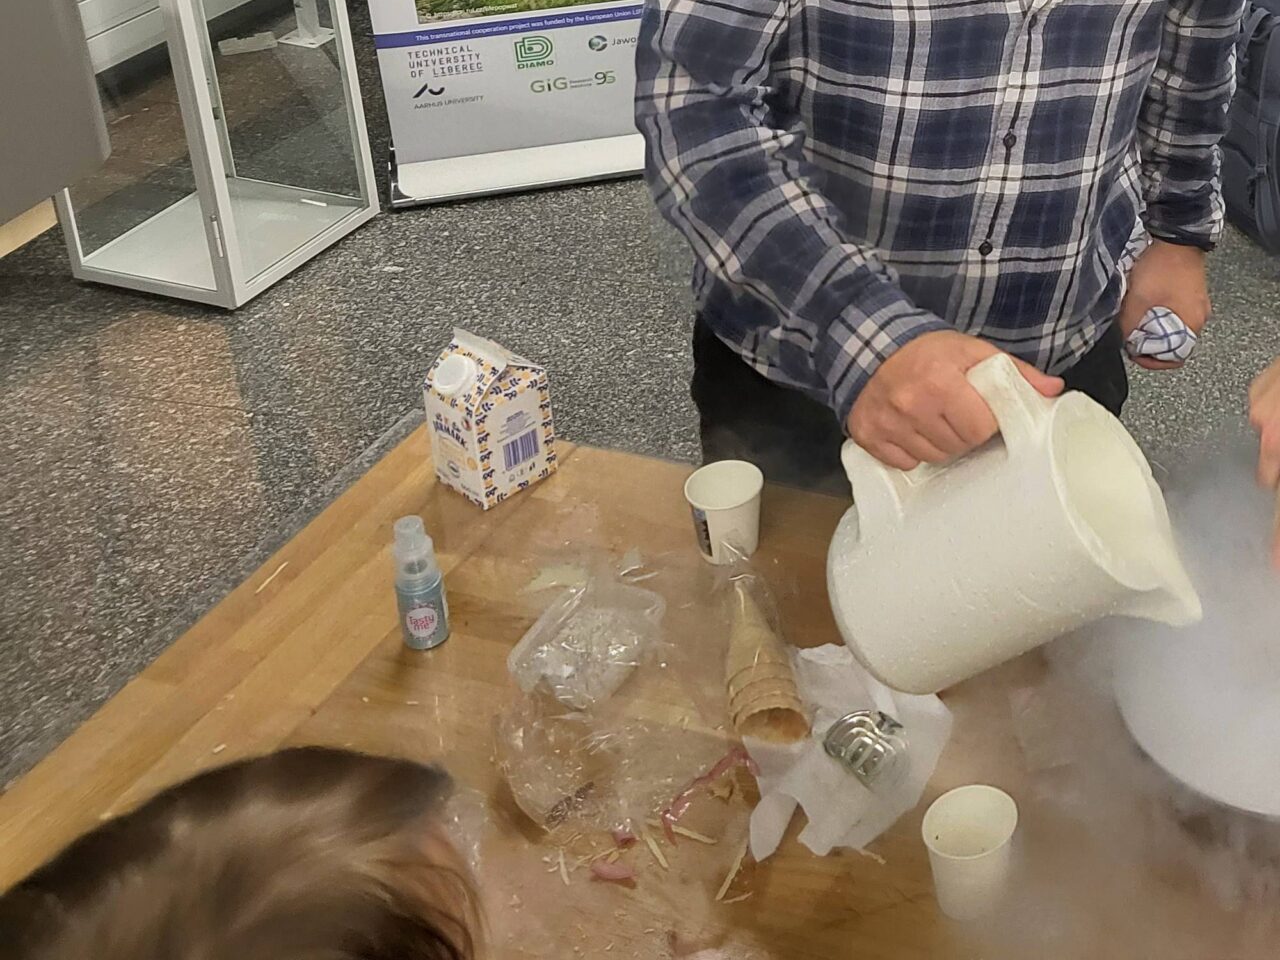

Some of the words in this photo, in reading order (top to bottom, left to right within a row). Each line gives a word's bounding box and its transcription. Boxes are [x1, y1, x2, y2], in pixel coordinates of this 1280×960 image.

[430, 29, 471, 39] transnational
[472, 25, 508, 36] cooperation
[509, 22, 530, 32] project
[586, 13, 614, 22] European
[614, 10, 631, 18] Union
[632, 7, 644, 15] LIF
[612, 37, 637, 46] Jawo
[408, 45, 473, 59] TECHNICAL
[409, 53, 481, 69] UNIVERSITY
[517, 60, 554, 69] DIAMO
[411, 69, 424, 78] OF
[433, 62, 483, 77] LIBEREC
